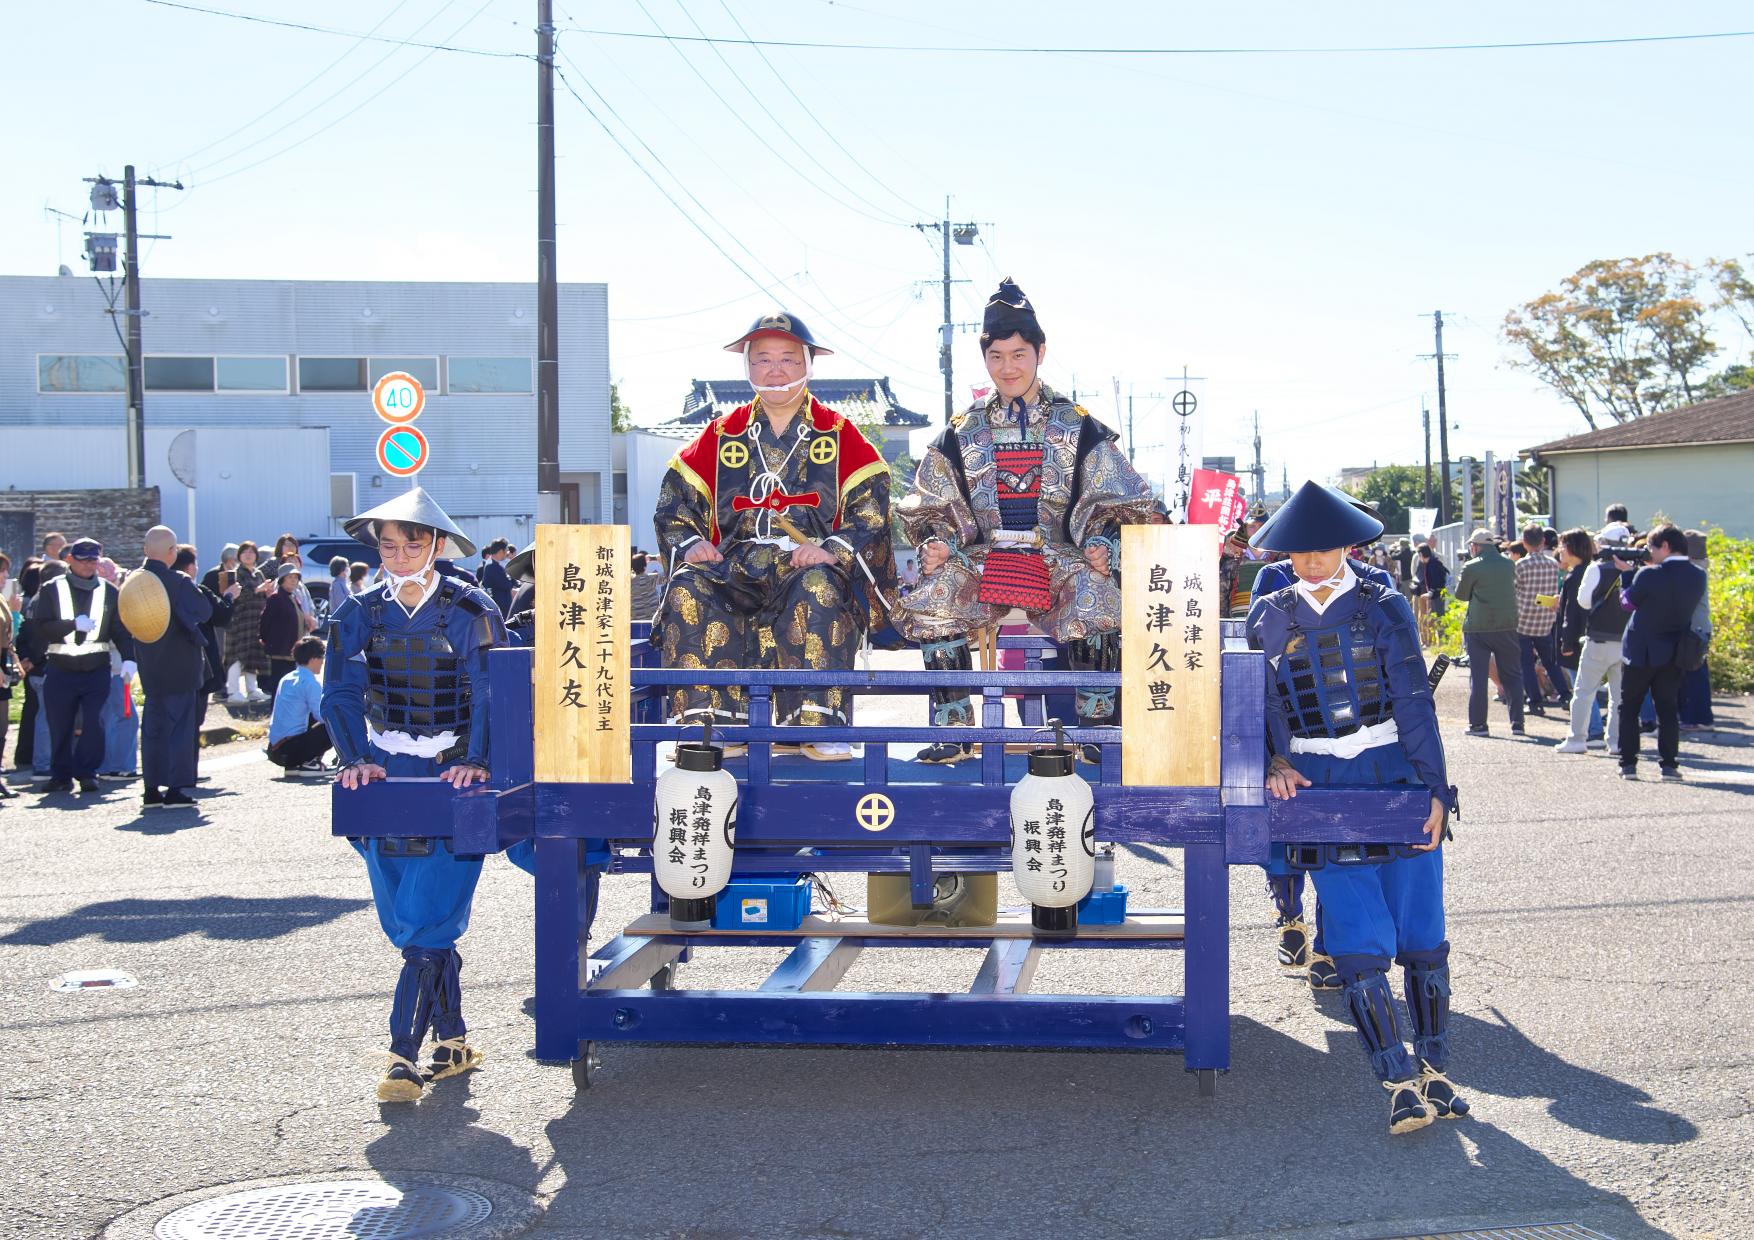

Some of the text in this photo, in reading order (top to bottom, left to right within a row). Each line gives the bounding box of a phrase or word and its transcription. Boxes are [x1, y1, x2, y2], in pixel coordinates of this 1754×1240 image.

[386, 387, 413, 409] 40
[1200, 488, 1223, 509] 平
[559, 562, 588, 709] 島津久友
[595, 545, 614, 731] 都城島津家二十九代当主
[1145, 564, 1175, 712] 島津久豊
[668, 807, 688, 865] 振興会
[690, 785, 713, 889] 島津発祥まつり
[1023, 819, 1044, 873] 振興会
[1044, 798, 1068, 893] 島津発祥まつり
